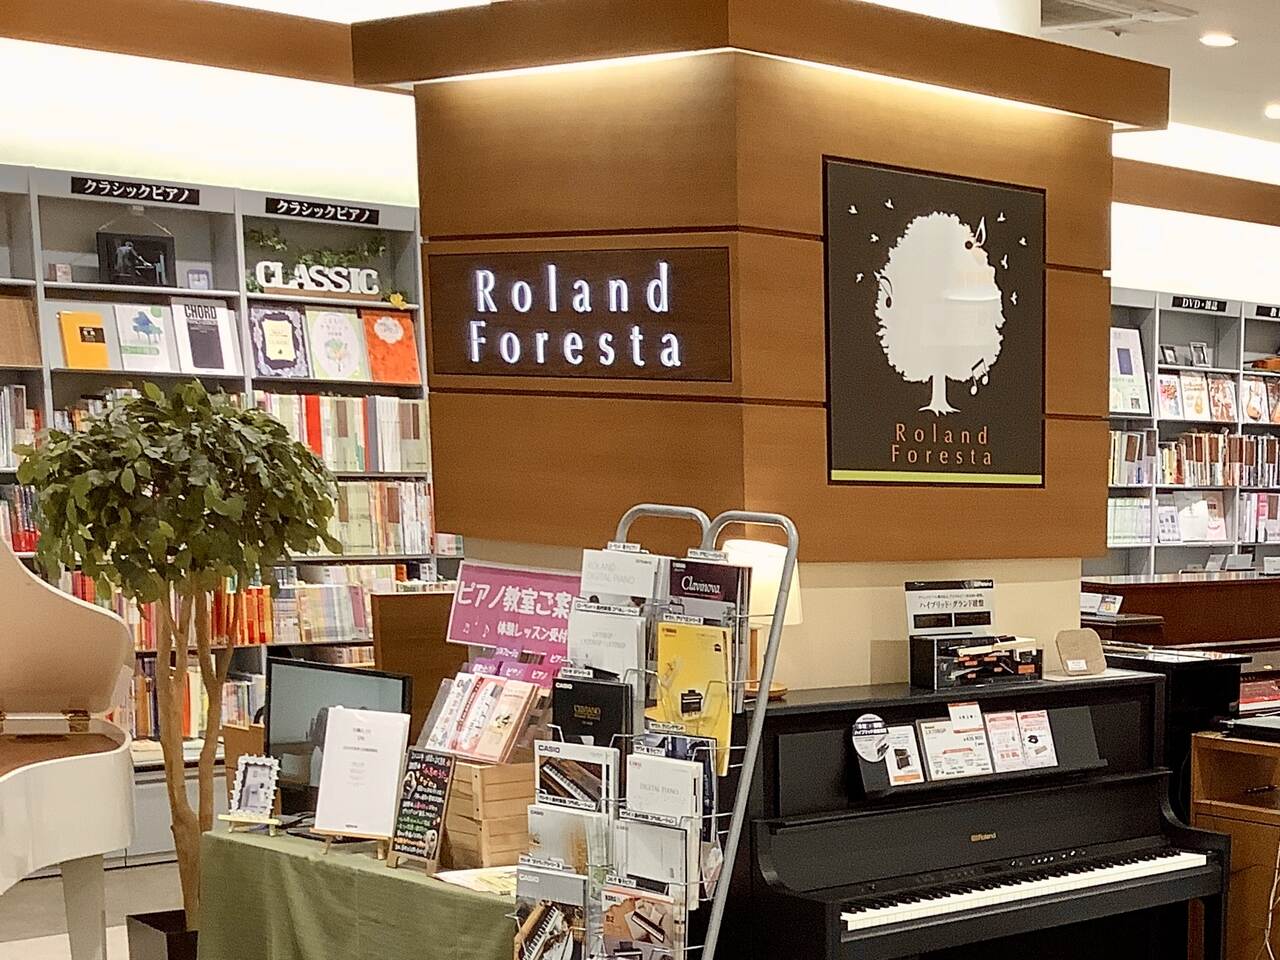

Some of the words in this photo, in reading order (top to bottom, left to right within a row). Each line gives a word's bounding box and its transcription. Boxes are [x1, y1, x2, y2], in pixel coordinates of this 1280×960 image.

[83, 179, 190, 203] クラシックピアノ
[276, 200, 372, 222] クラシックピアノ
[255, 261, 378, 295] CLASSIC
[476, 261, 671, 315] Roland
[184, 304, 217, 319] CHORD
[470, 320, 682, 369] Foresta
[896, 423, 988, 444] Roland
[892, 445, 992, 465] Foresta
[682, 576, 721, 594] Clavinova
[539, 744, 560, 753] CASIO
